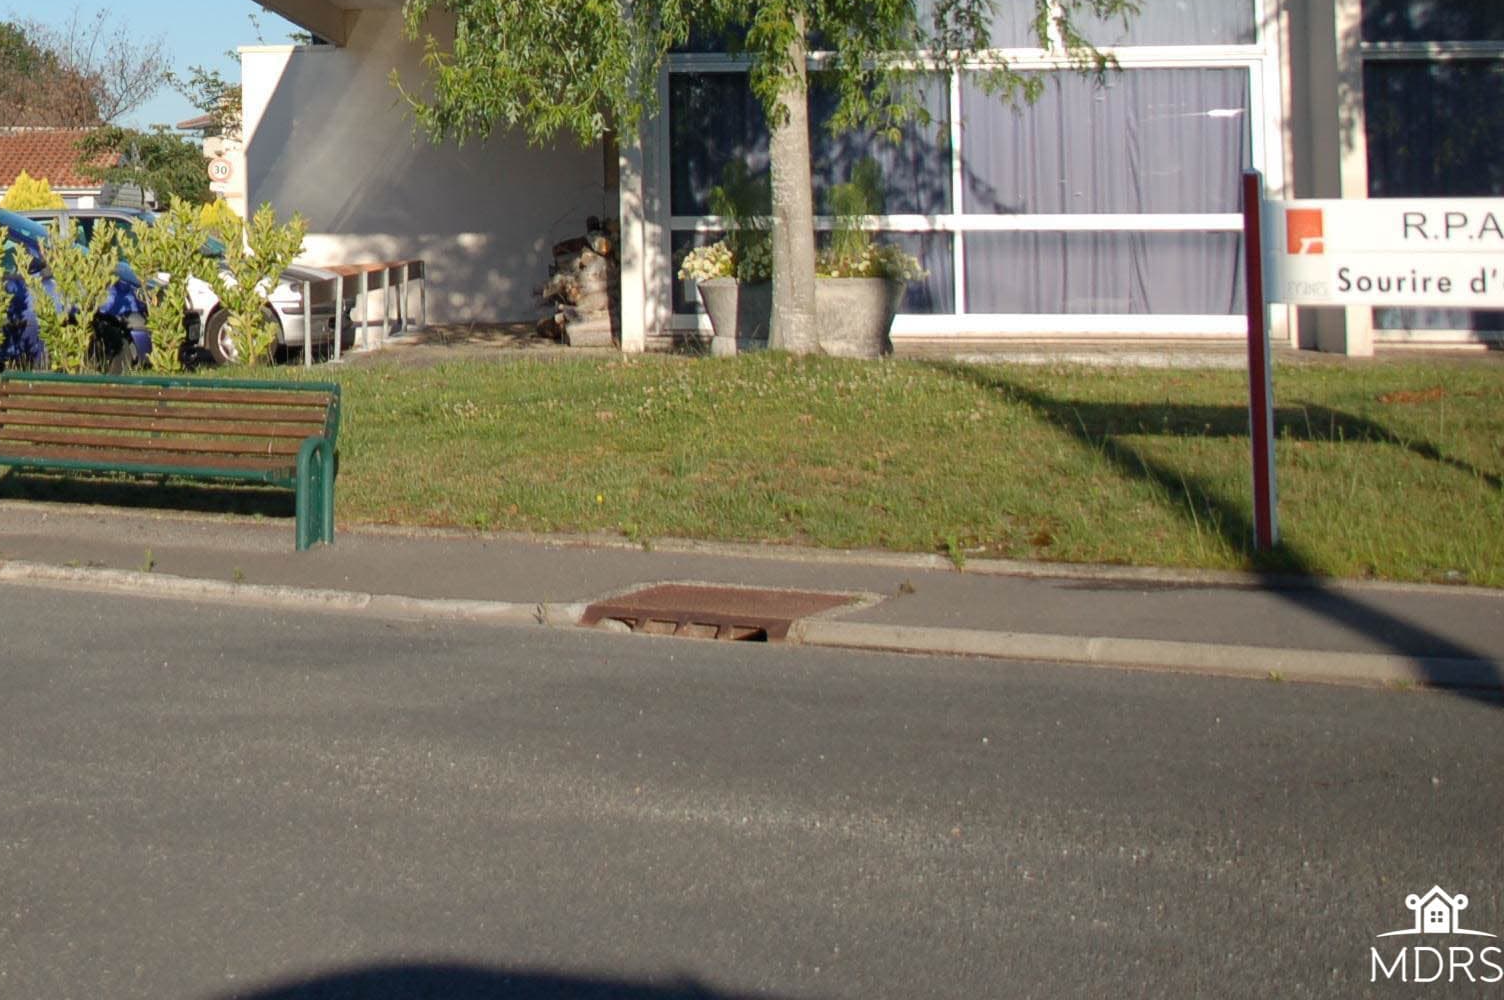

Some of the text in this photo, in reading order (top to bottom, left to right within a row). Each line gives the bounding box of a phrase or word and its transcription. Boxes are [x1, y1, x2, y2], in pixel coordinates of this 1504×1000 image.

[214, 164, 227, 175] 30
[1337, 267, 1453, 293] Sourire
[1469, 267, 1504, 294] d'
